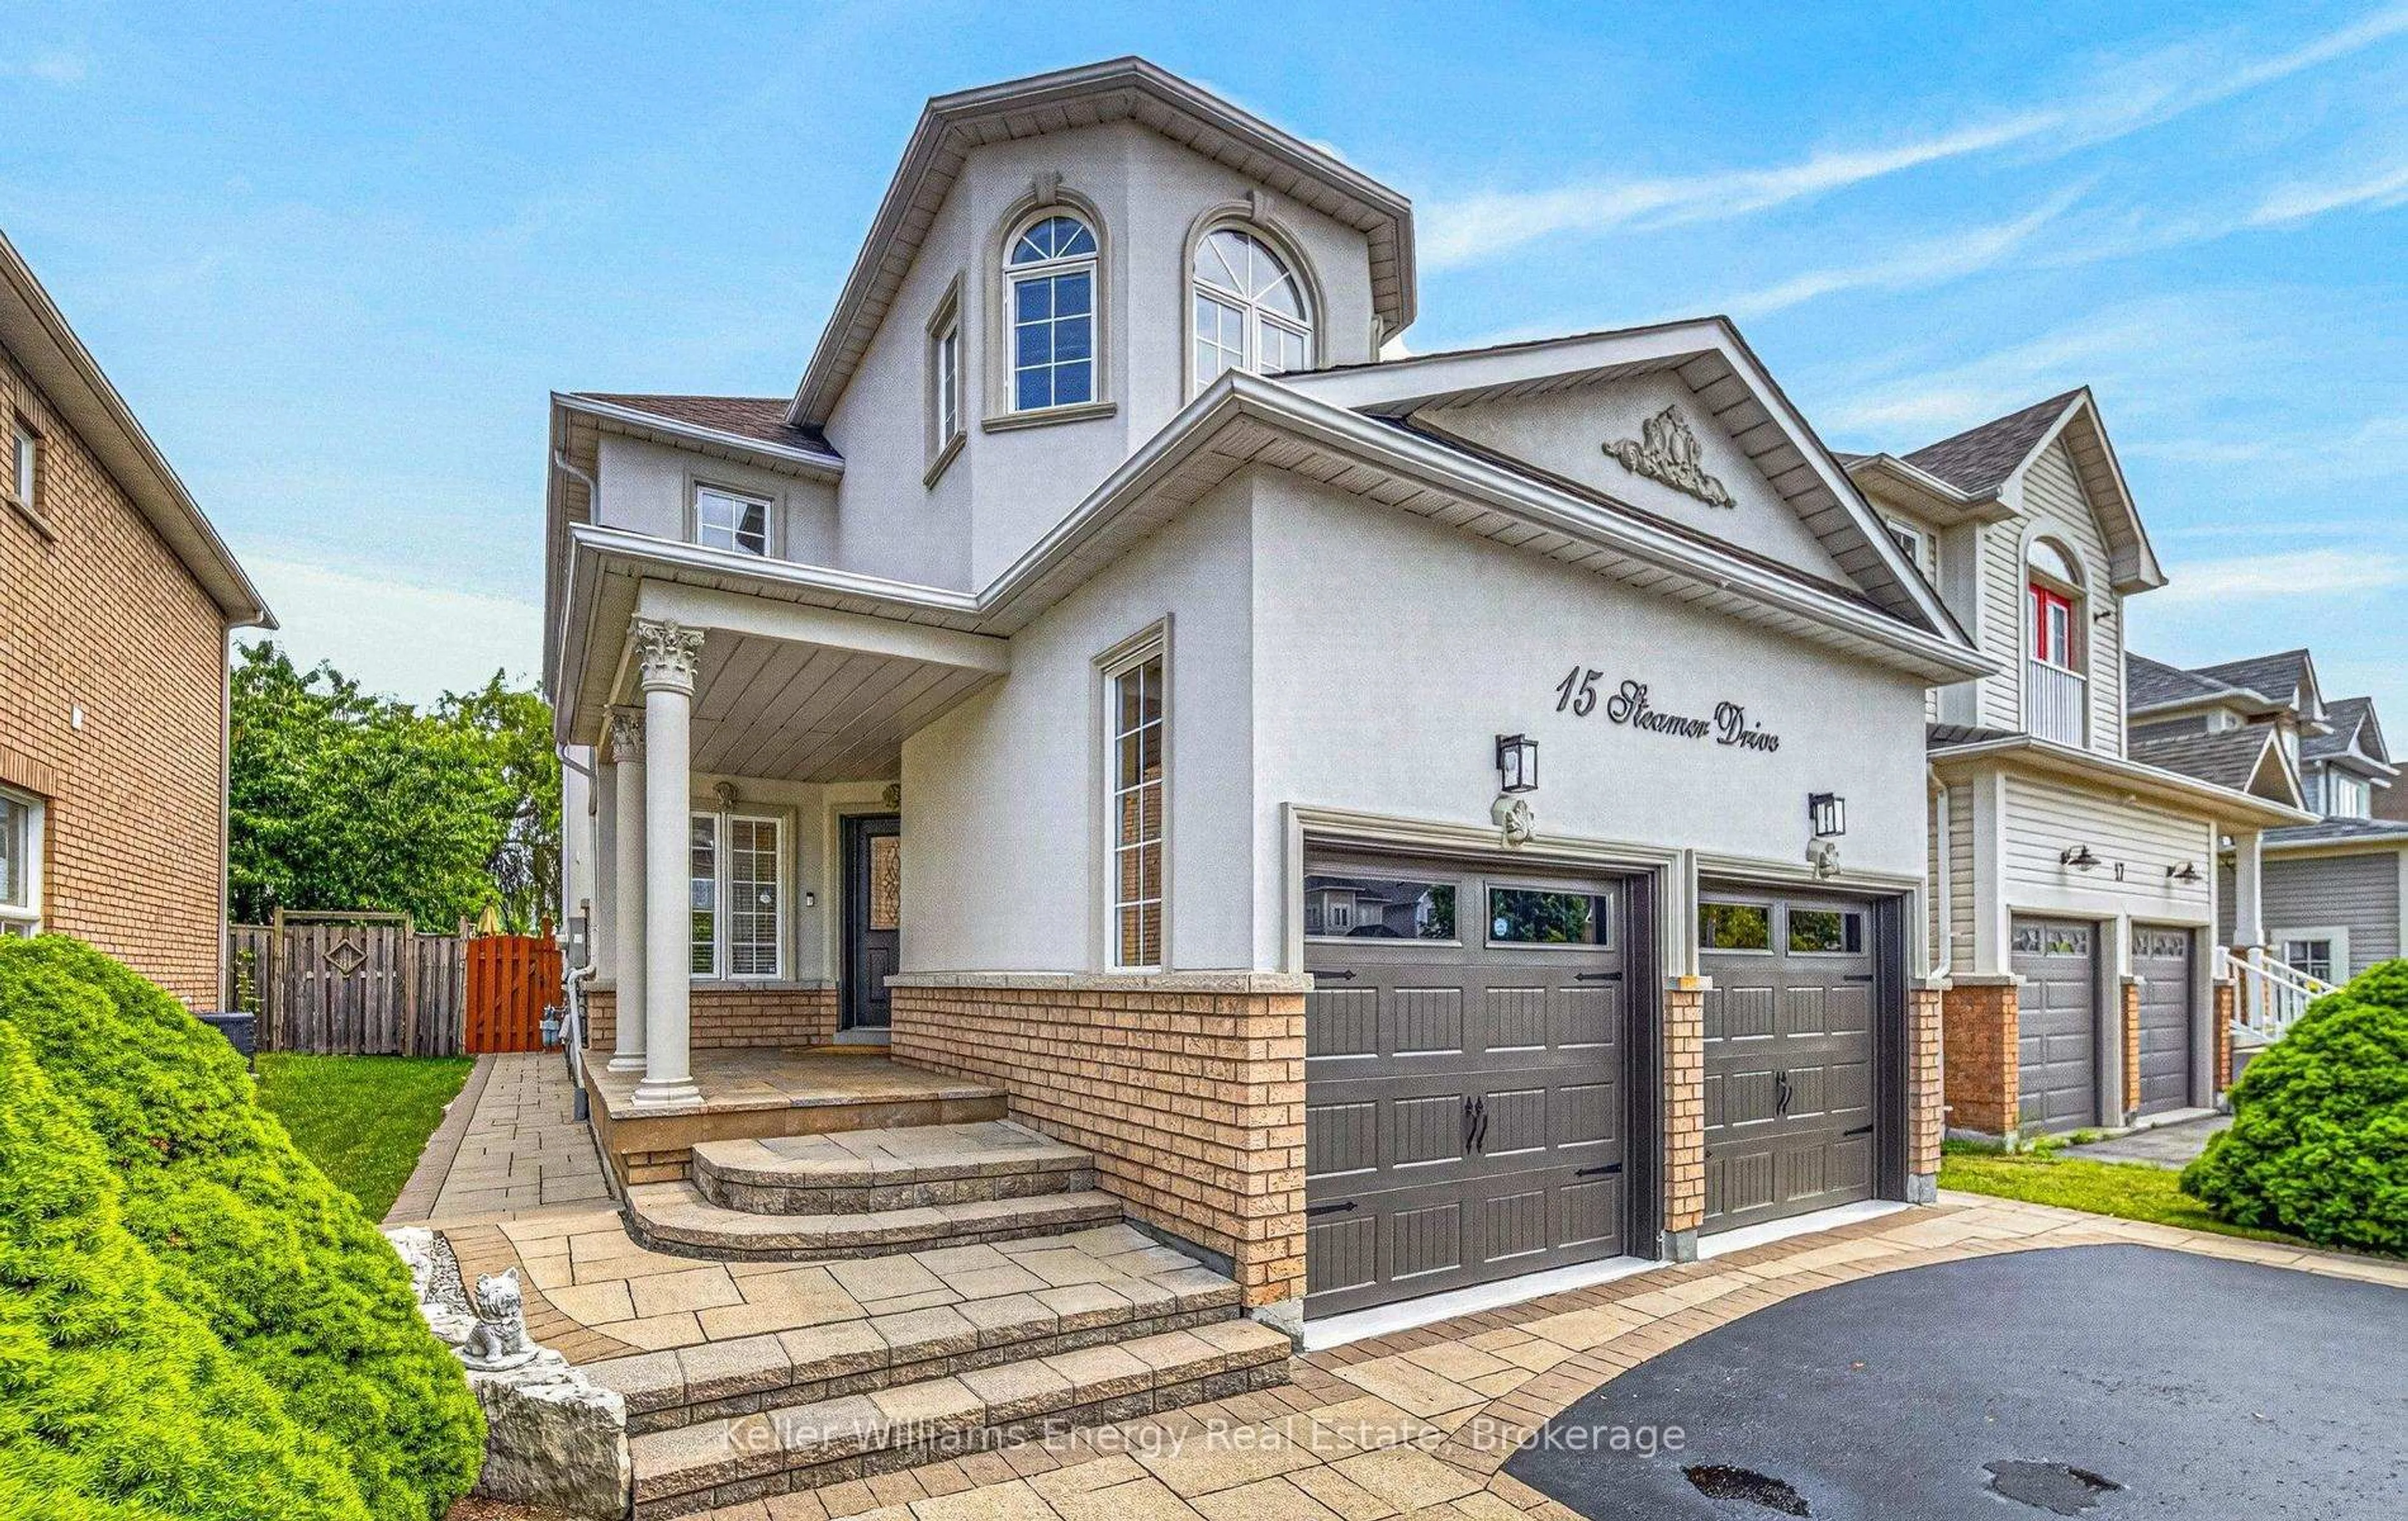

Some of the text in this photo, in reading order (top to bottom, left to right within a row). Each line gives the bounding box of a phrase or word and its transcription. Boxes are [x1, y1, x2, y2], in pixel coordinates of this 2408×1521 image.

[1556, 665, 1780, 753] 15 Steamer Drive
